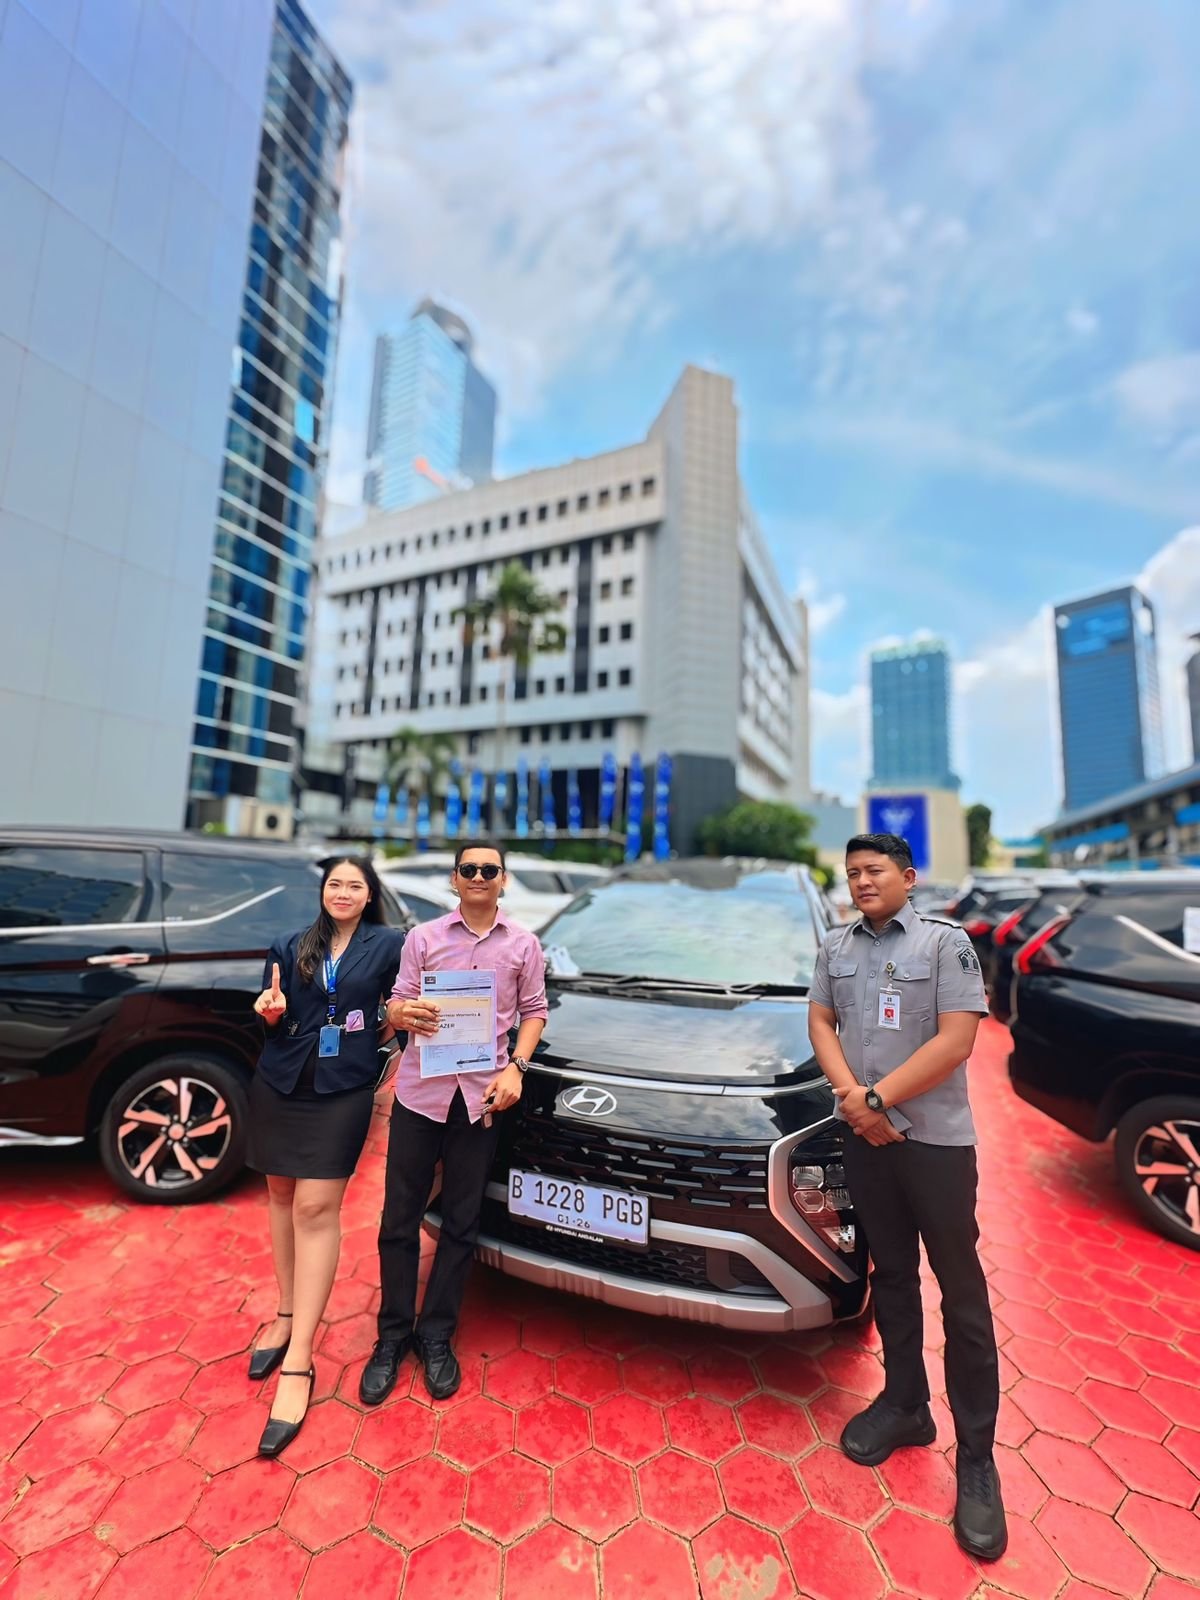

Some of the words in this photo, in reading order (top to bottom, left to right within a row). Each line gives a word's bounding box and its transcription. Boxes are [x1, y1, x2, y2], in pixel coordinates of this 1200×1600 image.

[512, 1175, 523, 1199] B
[534, 1180, 585, 1213] 1228
[602, 1194, 643, 1226] PGB
[554, 1226, 577, 1237] HYUNDAI
